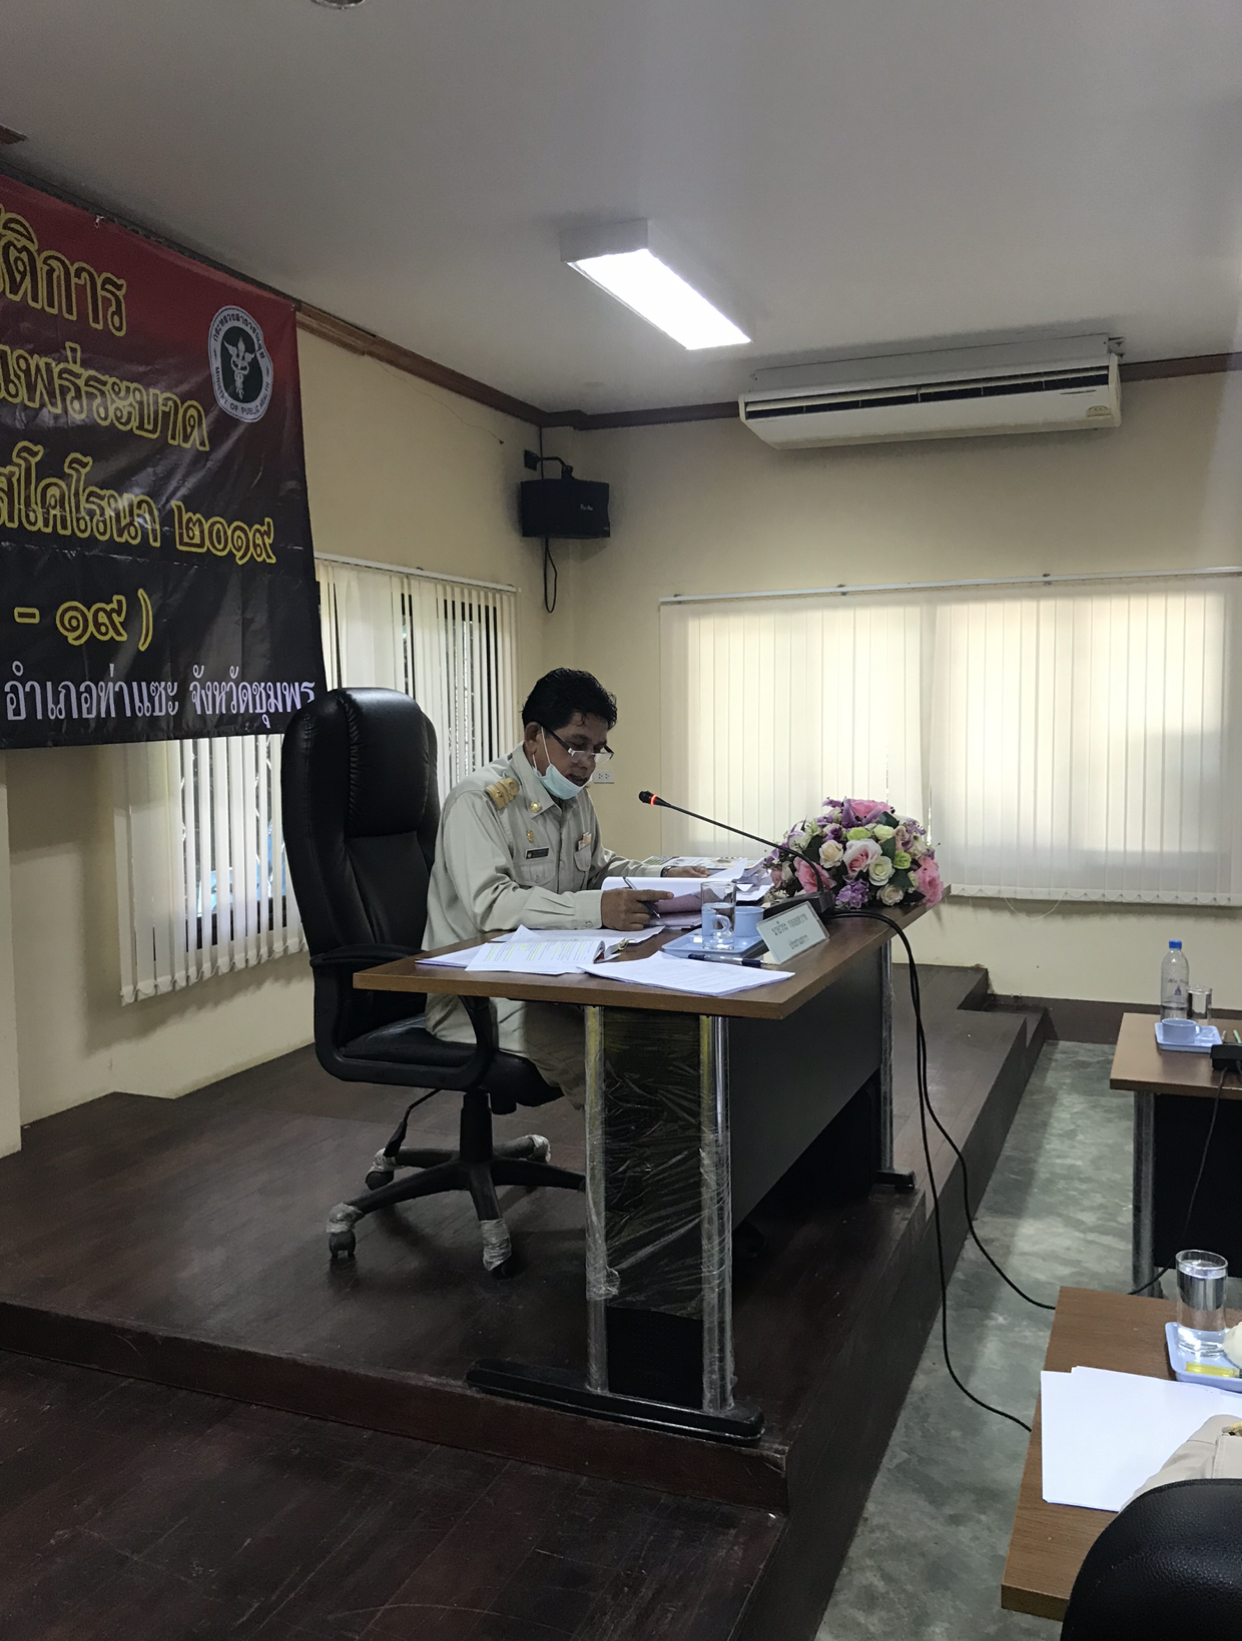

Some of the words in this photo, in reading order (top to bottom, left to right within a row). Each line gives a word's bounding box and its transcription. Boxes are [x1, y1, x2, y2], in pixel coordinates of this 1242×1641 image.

[0, 203, 126, 336] ติการ
[230, 403, 239, 412] OF
[171, 501, 277, 565] ๒๐๑๙
[56, 595, 127, 646] ๑๙
[4, 661, 178, 721] อำเภอท่าแซะ
